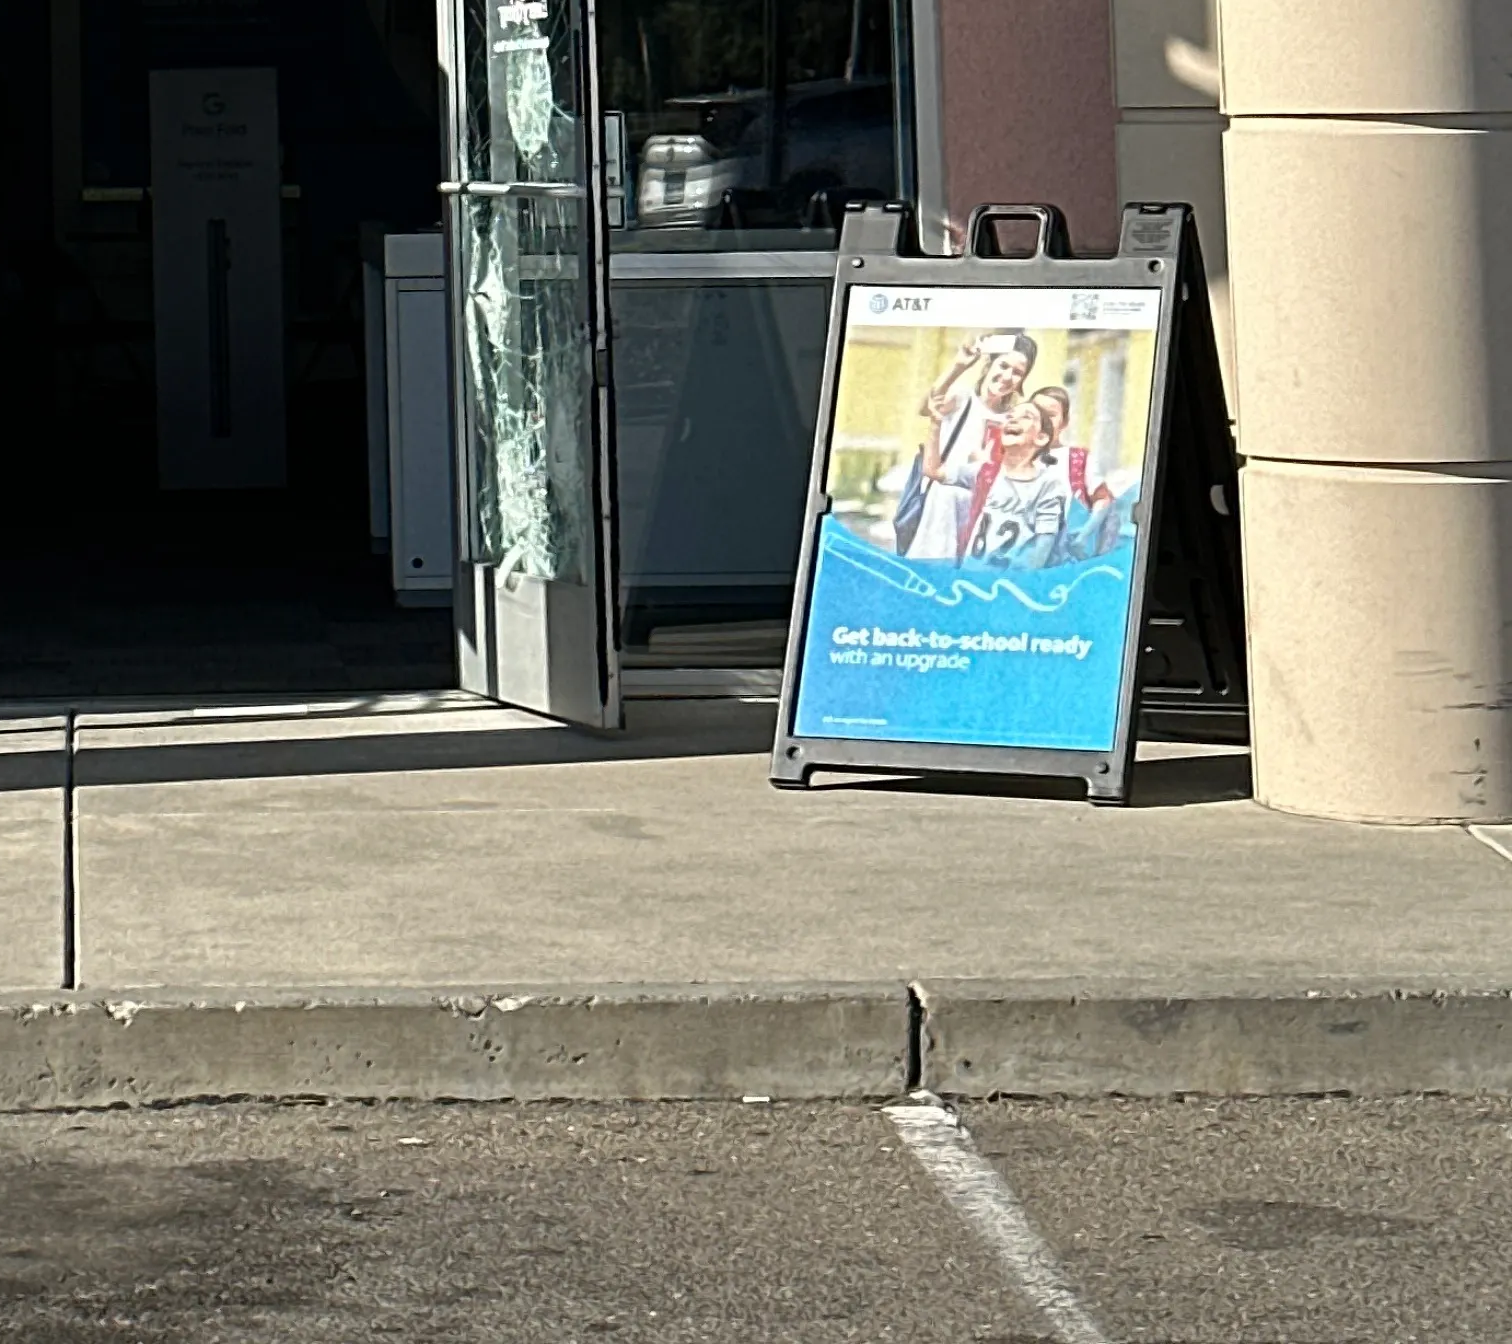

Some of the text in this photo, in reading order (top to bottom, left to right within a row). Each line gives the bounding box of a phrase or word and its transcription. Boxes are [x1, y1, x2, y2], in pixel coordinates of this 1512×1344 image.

[892, 297, 933, 311] AT&T
[831, 626, 1093, 660] Get back-to-school ready
[829, 648, 971, 673] with an upgrade
